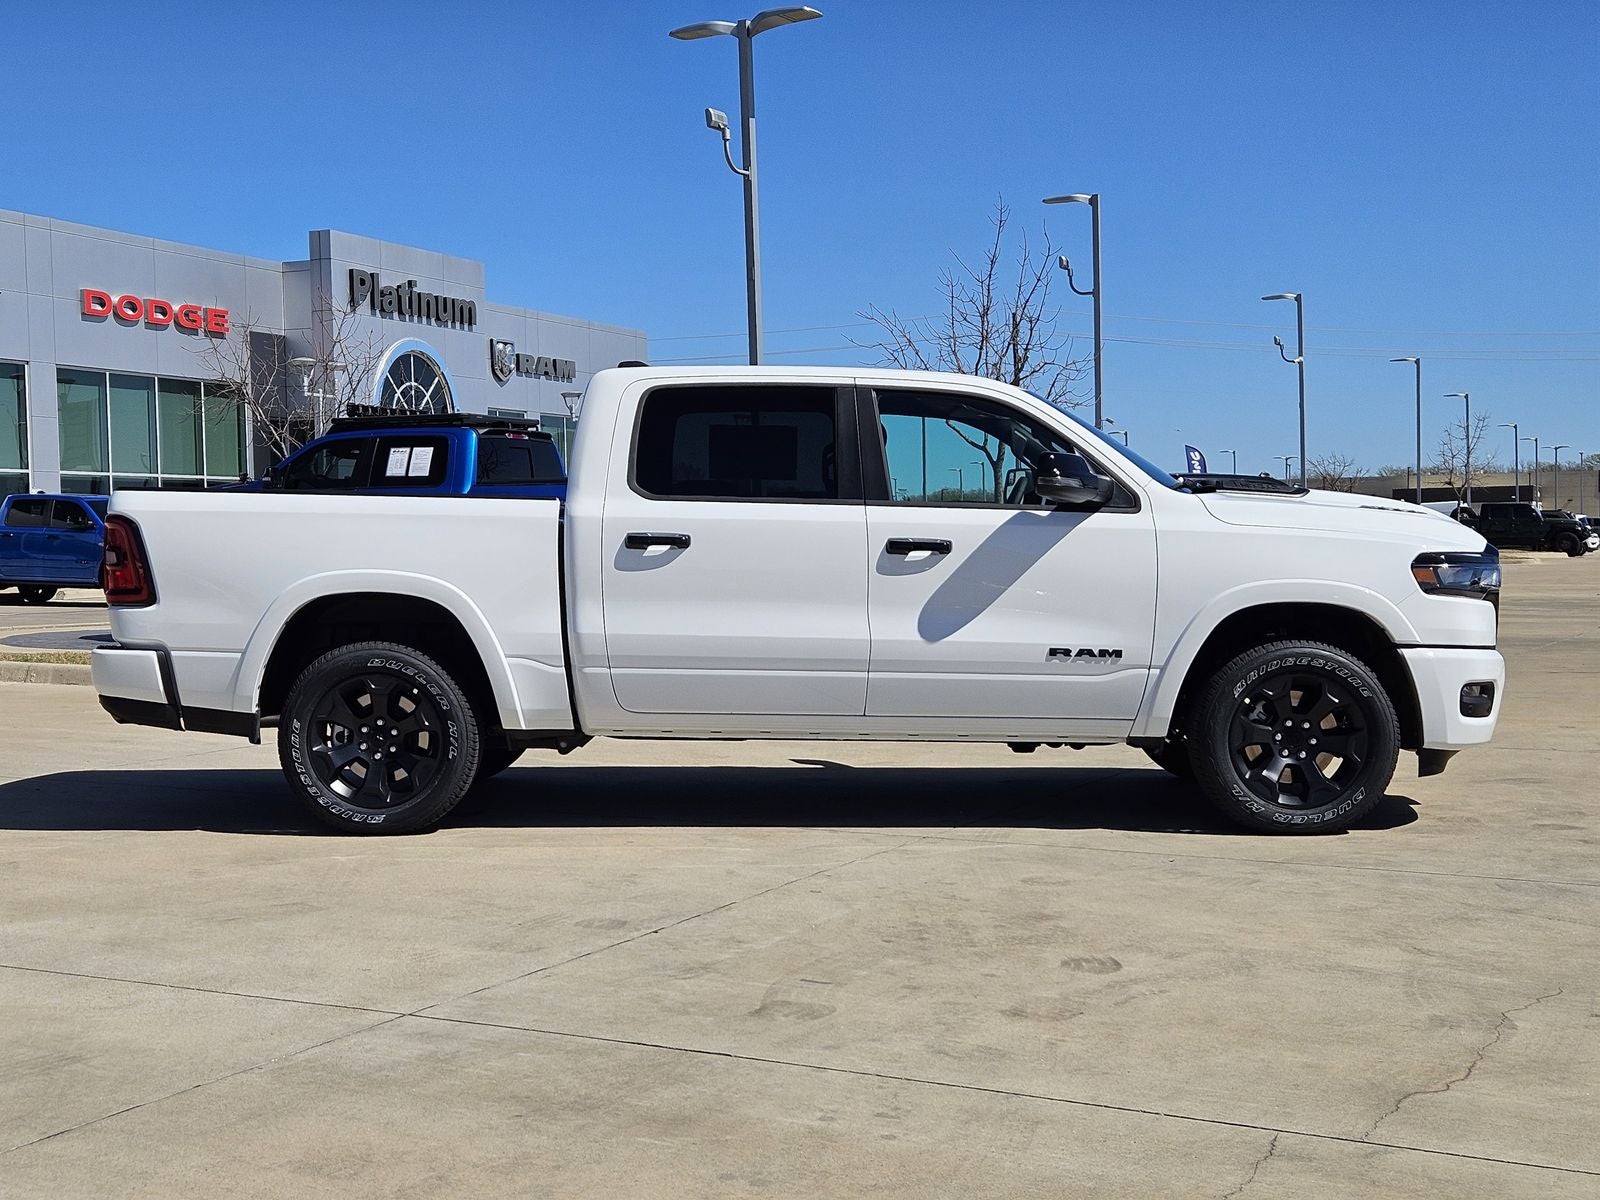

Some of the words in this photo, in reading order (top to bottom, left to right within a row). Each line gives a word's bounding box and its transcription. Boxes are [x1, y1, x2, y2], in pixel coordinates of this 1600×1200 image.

[80, 288, 230, 335] DODGE
[348, 268, 477, 327] Platinum
[515, 353, 577, 379] RAM
[1048, 647, 1123, 659] RAM
[367, 658, 451, 710] DUELER
[1233, 656, 1373, 698] BRIDGESTONE
[292, 719, 386, 824] BRIDGESTONE
[1273, 787, 1366, 824] DUELER
